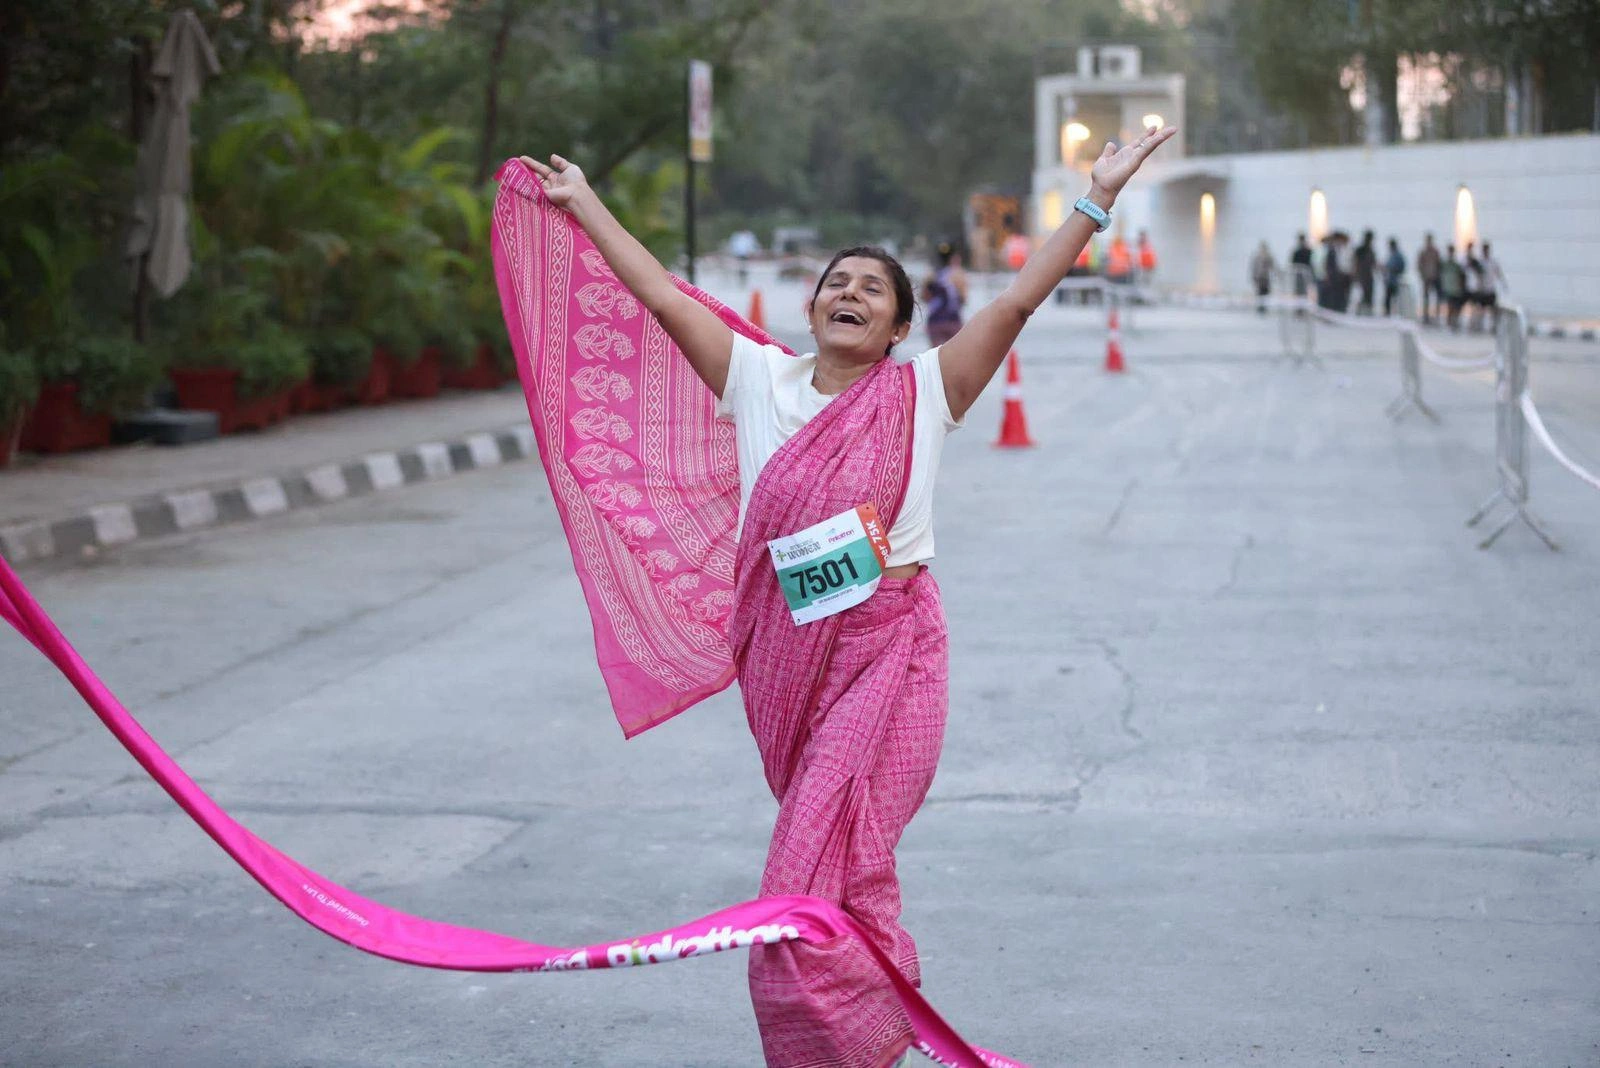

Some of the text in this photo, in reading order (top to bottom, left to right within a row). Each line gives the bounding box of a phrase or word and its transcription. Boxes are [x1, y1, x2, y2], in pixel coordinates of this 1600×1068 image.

[866, 520, 882, 544] 75K
[787, 541, 821, 560] WOMEN
[790, 551, 859, 599] 7501
[316, 893, 328, 905] To
[326, 899, 369, 927] Dedicated
